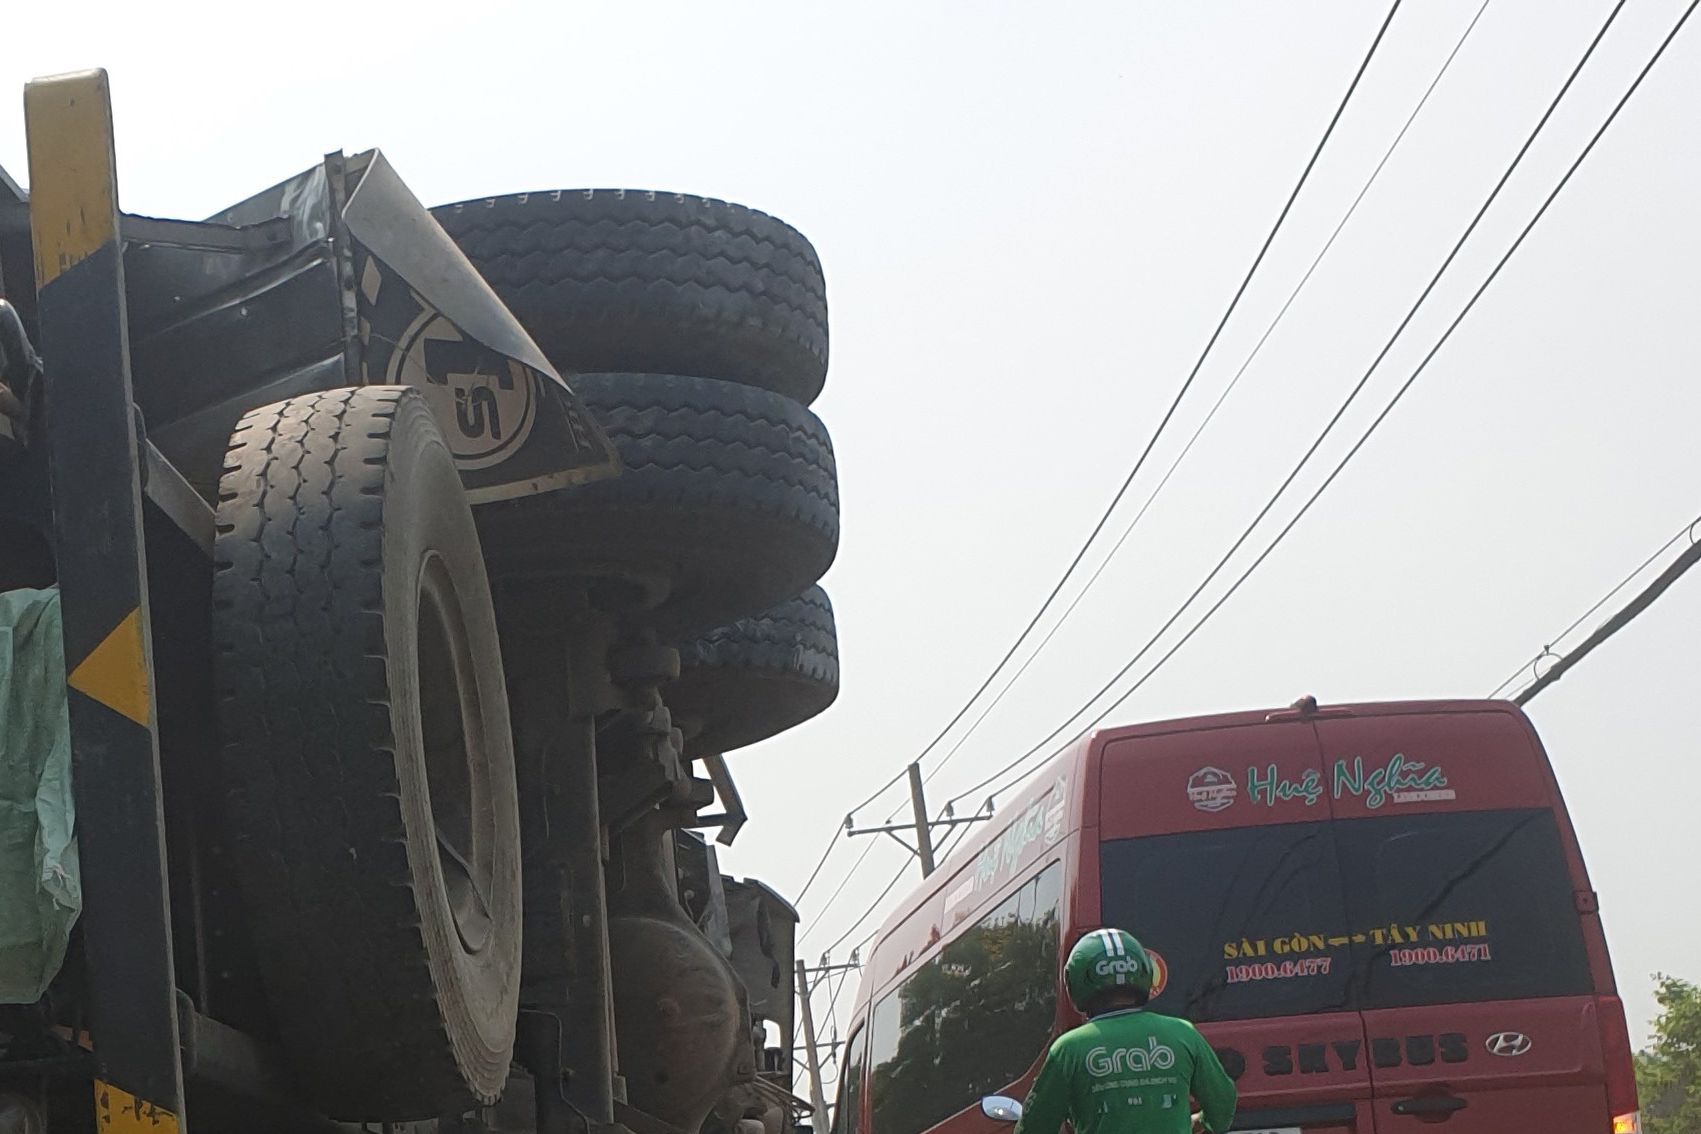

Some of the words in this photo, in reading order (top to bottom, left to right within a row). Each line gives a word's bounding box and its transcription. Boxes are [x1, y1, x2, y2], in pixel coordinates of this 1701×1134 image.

[1247, 763, 1323, 806] Huệ
[1332, 753, 1449, 809] Nghĩa
[1223, 937, 1267, 960] SÀI
[1272, 932, 1325, 955] GÒN
[1369, 924, 1420, 946] TÂY
[1428, 920, 1488, 940] NINH
[1096, 956, 1138, 976] Grab
[1226, 957, 1332, 983] 1900.6477
[1389, 943, 1492, 966] 1900.6471
[1086, 1036, 1175, 1077] Grab
[1262, 1032, 1468, 1075] SKYBUS
